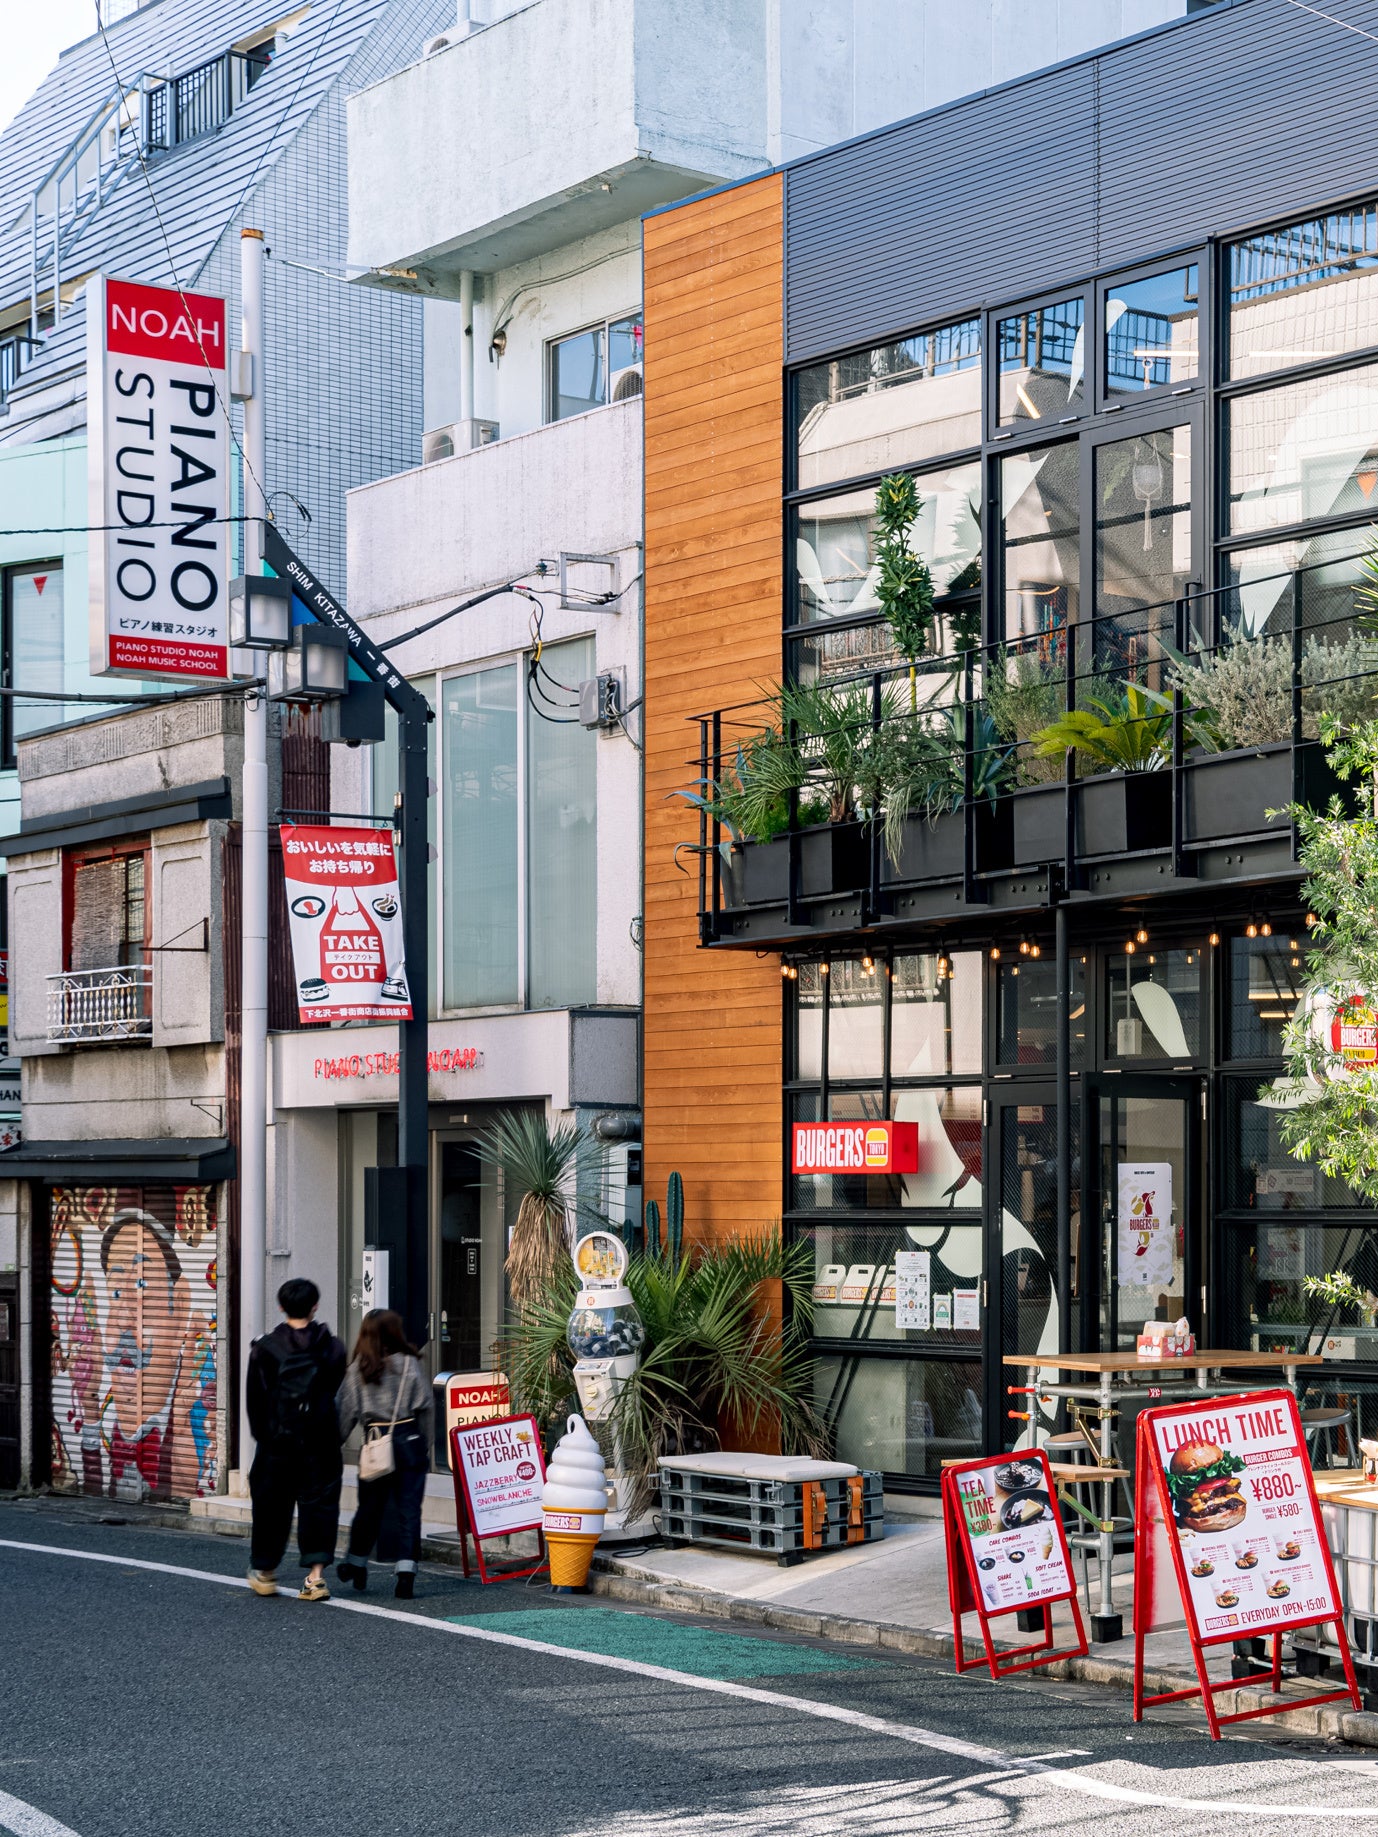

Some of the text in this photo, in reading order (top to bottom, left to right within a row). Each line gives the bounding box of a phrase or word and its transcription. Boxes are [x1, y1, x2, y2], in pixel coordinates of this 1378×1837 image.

[111, 303, 219, 347] NOAH
[115, 368, 156, 602] STUDIO
[170, 379, 218, 612] PIANO
[119, 617, 218, 638] ピアノ練習スタジオ
[116, 641, 218, 659] PIANO STUDIO NOAH
[116, 653, 218, 670] NOAH MUSIC SCHOOL
[286, 840, 392, 857] おいしいを気軽に
[309, 860, 375, 875] お持ち帰り
[323, 935, 380, 951] TAKE
[331, 965, 378, 980] OUT
[1341, 1028, 1377, 1047] BURGERS
[314, 1055, 361, 1079] PIANO
[427, 1047, 478, 1073] NOAH
[796, 1128, 885, 1168] BURGERS TOKYO
[1129, 1218, 1152, 1230] BURGERS
[458, 1390, 501, 1405] NOAH
[463, 1428, 512, 1451] WEEKLY
[1162, 1408, 1287, 1453] LUNCH TIME
[467, 1442, 532, 1468] TAP CRAFT
[1244, 1449, 1293, 1464] BURGER COMBOS
[474, 1474, 518, 1490] JAZZBERRY
[961, 1478, 986, 1498] TEA
[476, 1488, 533, 1507] SNOWBLANCHE
[966, 1496, 997, 1518] TIME
[1047, 1561, 1063, 1569] CREAM
[1241, 1607, 1280, 1624] EVERYDAY
